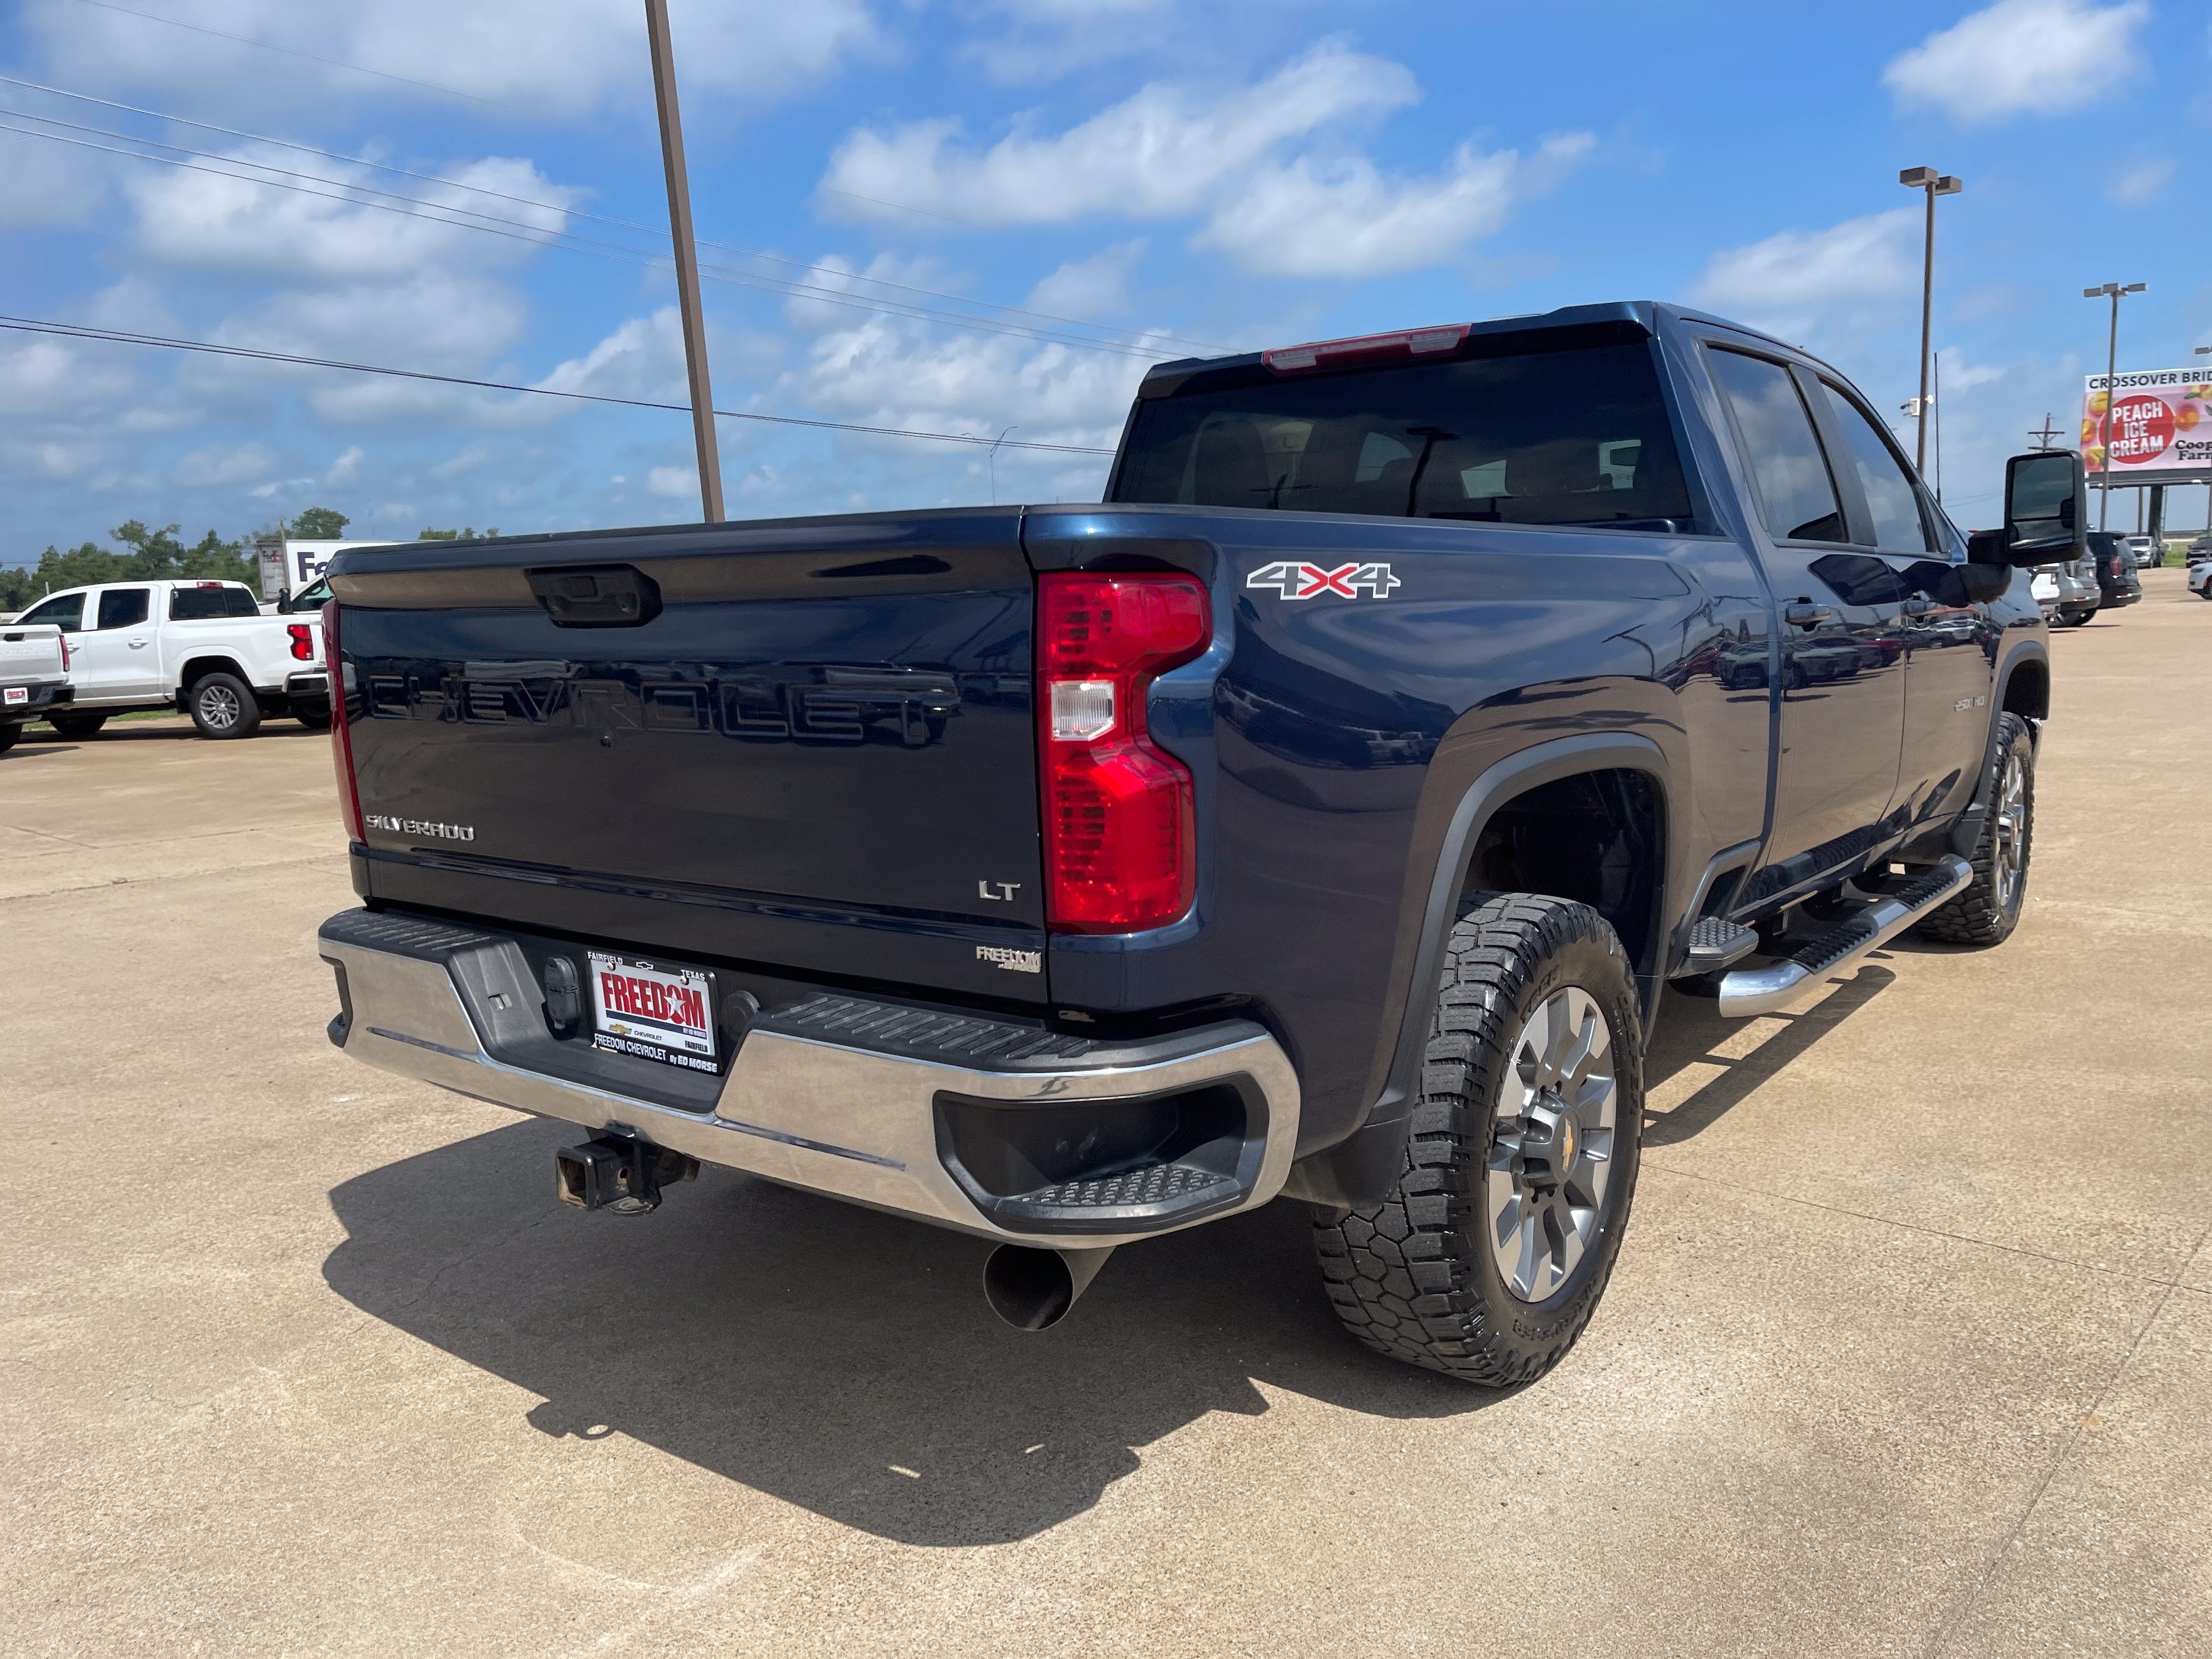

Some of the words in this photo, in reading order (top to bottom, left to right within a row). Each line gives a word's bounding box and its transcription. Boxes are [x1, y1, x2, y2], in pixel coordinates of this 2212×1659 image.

[2089, 373, 2177, 388] CROSSOVER
[2112, 402, 2163, 424] PEACH
[2124, 420, 2149, 438] ICE
[2110, 435, 2164, 458] CREAM
[2175, 439, 2212, 451] Coop
[369, 675, 960, 744] CHEVROLET
[366, 815, 475, 841] SILVERADO
[979, 881, 1022, 901] LT
[588, 951, 623, 966] FAIRFIELD
[976, 946, 1042, 967] FREEDOM
[680, 969, 706, 981] TEXAS
[600, 972, 706, 1030] FREEDOM
[634, 1030, 662, 1041] CHEVROLET
[595, 1033, 625, 1052] FREEDOM
[627, 1041, 667, 1061] CHEVROLET
[678, 1054, 688, 1066] ED
[689, 1058, 718, 1073] MORSE
[685, 1040, 708, 1053] FAIRFIELD
